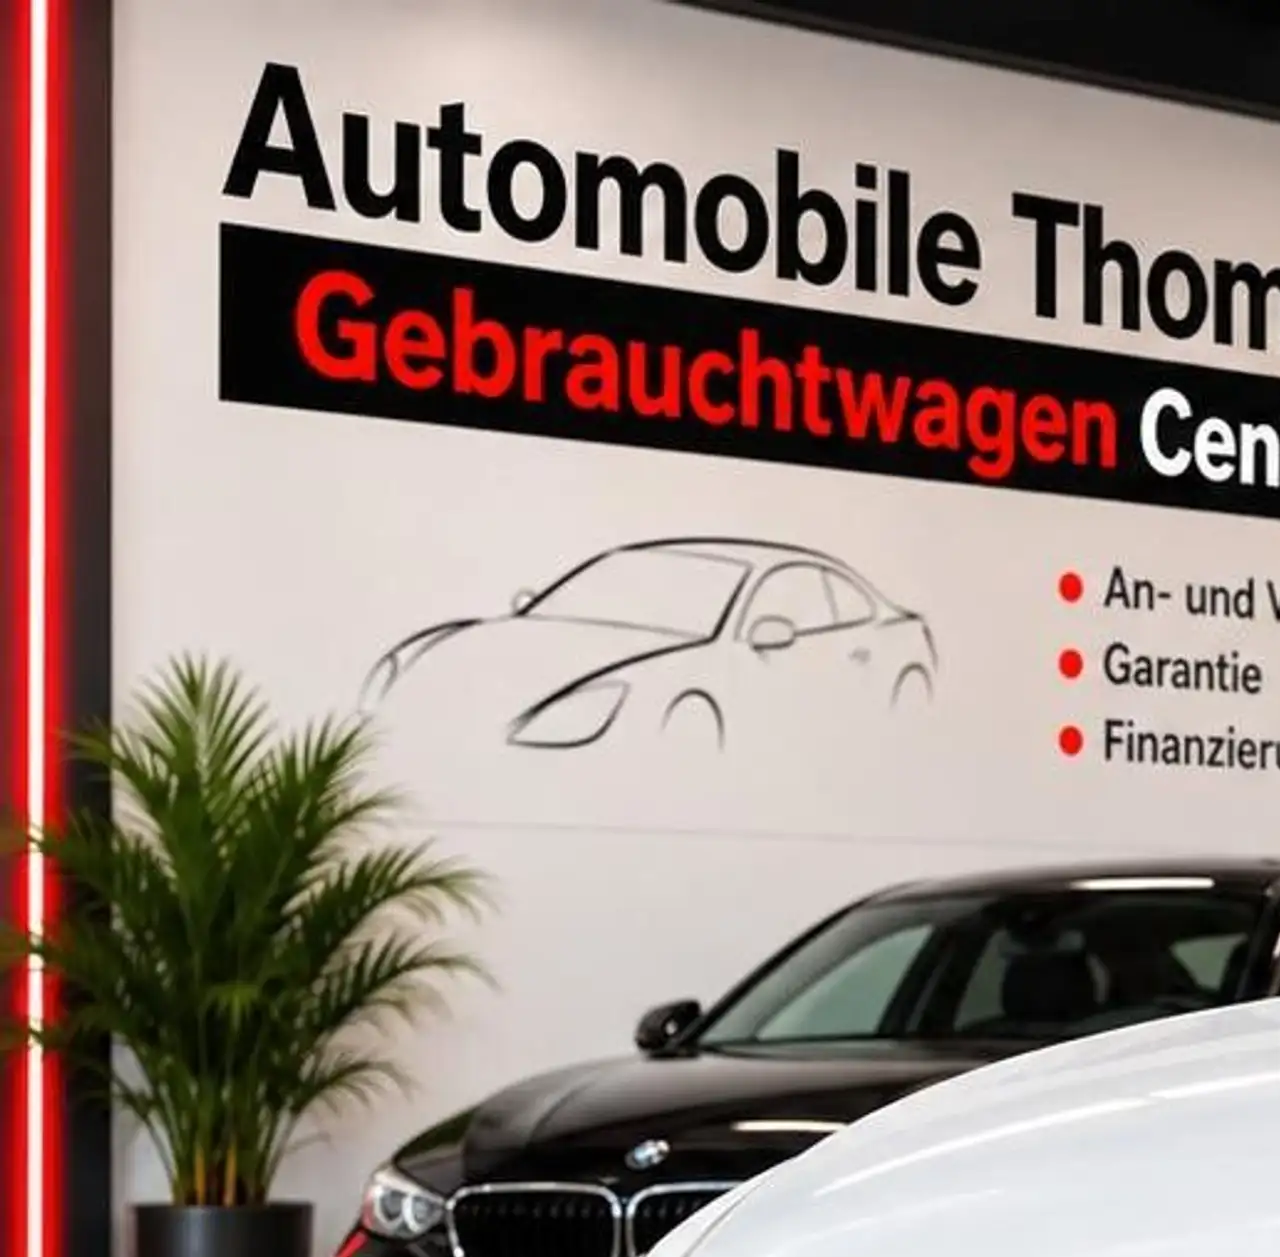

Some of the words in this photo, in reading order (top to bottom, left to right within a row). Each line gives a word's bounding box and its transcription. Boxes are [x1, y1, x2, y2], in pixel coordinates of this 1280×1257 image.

[222, 62, 984, 306] Automobile
[296, 270, 1118, 478] Gebrauchtwagen
[1103, 566, 1171, 611] An-
[1186, 578, 1254, 620] und
[1103, 642, 1262, 694] Garantie
